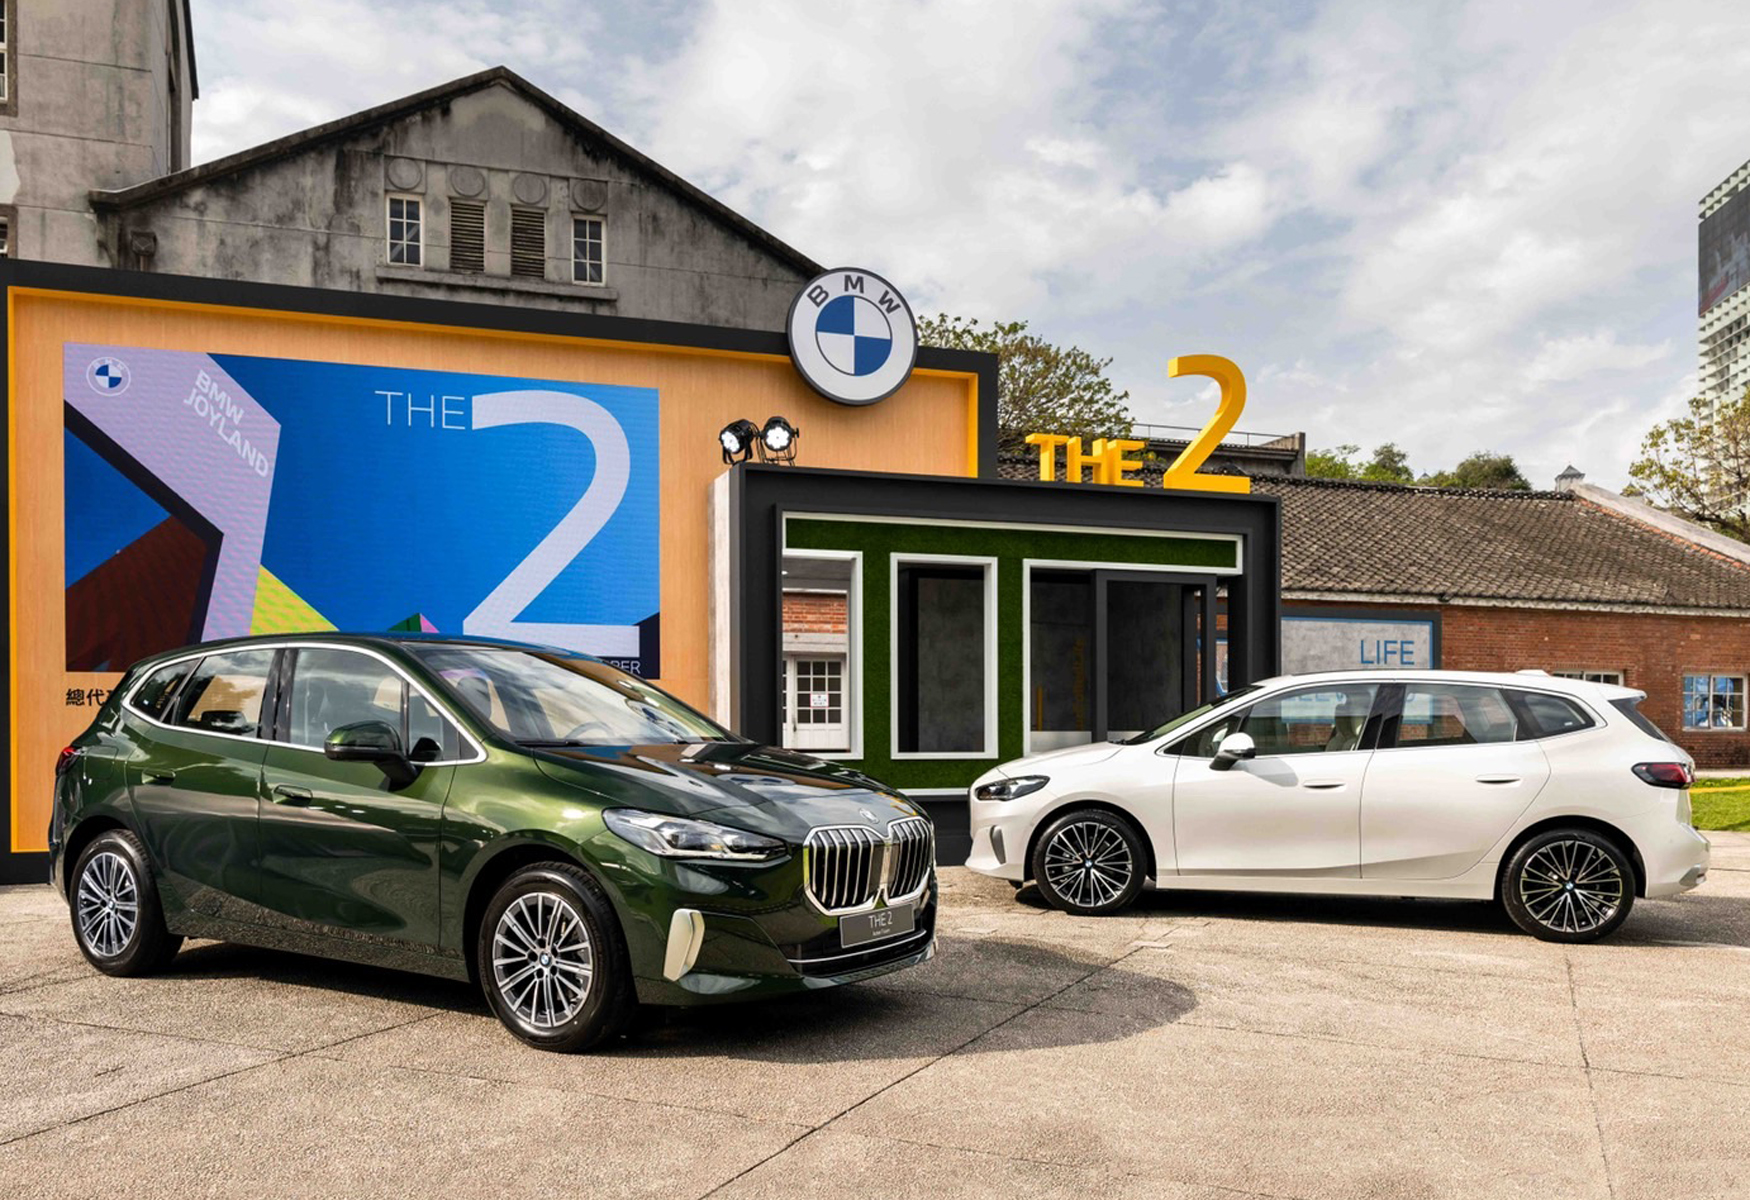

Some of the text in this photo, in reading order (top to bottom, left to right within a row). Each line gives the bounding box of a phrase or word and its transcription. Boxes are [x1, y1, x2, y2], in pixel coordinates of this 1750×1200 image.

[806, 274, 901, 315] BMW
[195, 368, 245, 425] BMW
[183, 387, 269, 478] JOYLAND
[1025, 353, 1251, 495] THE 2
[374, 389, 641, 658] THE 2
[1360, 639, 1415, 666] LIFE
[65, 688, 112, 706] 總代
[868, 911, 893, 929] THE 2
